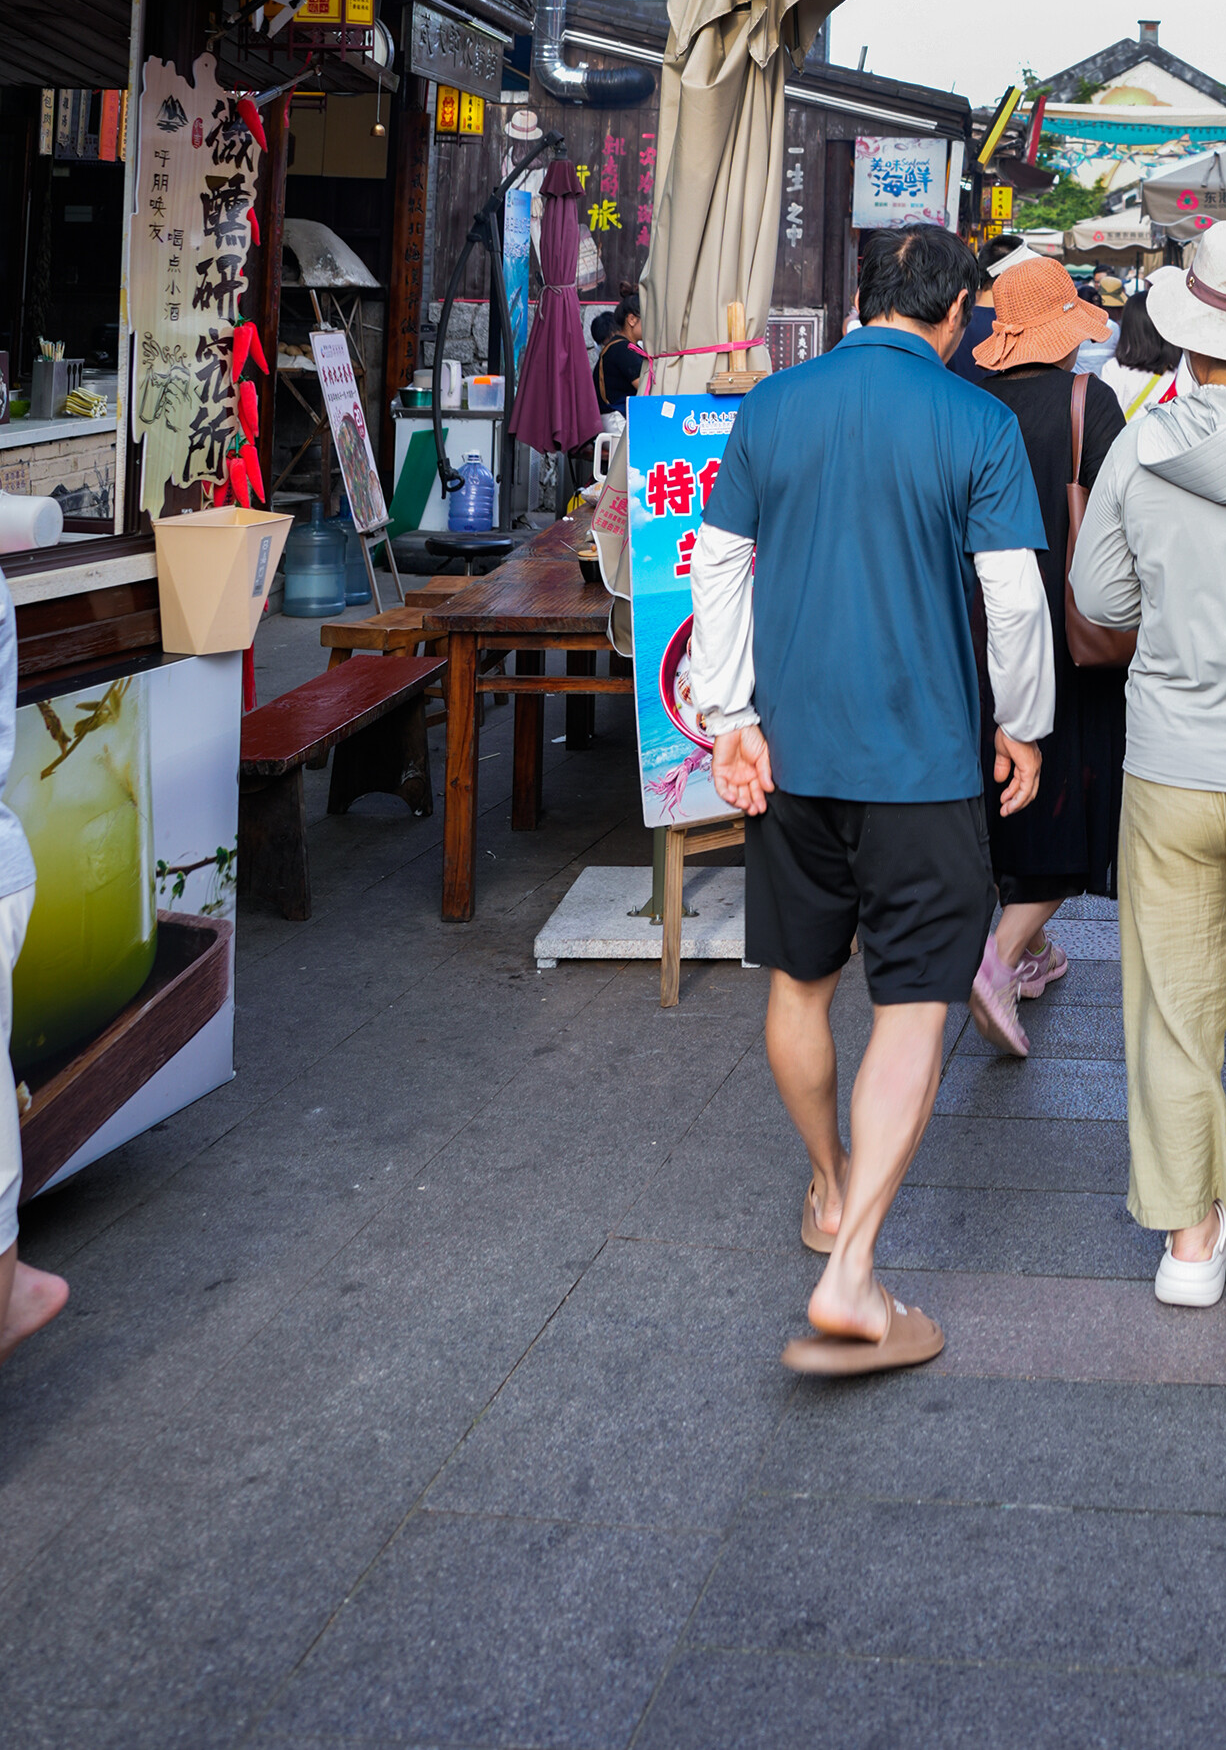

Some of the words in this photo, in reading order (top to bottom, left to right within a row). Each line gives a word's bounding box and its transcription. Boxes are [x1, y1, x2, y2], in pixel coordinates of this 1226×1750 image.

[149, 149, 171, 243] 呼朋唤友
[786, 147, 805, 248] 一生之中
[871, 166, 933, 198] 海鲜
[164, 228, 185, 323] 喝点小酒
